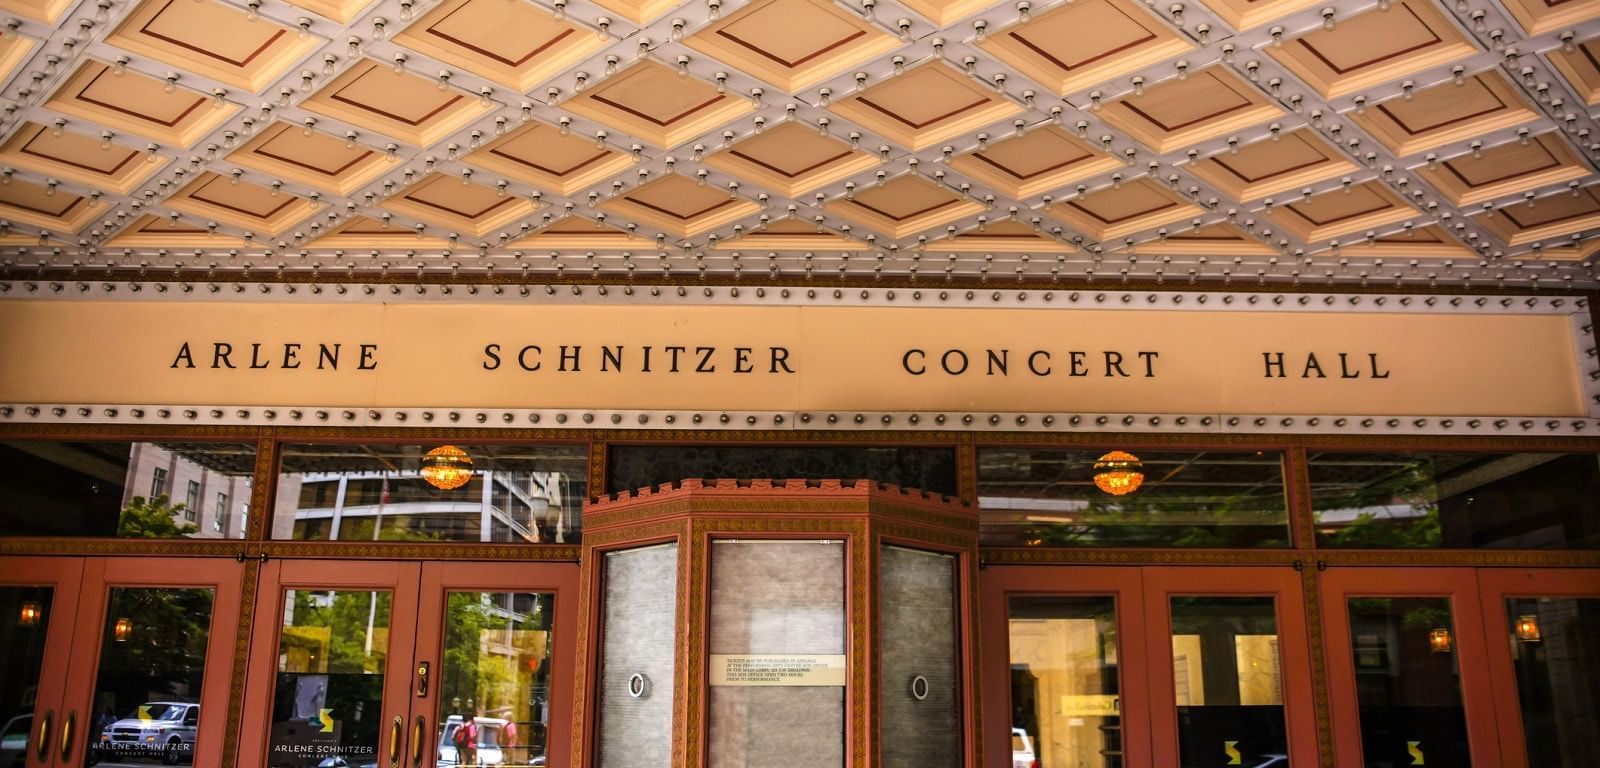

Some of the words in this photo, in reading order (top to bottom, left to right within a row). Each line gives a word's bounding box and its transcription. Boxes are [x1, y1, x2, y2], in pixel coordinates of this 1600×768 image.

[170, 341, 379, 371] ARLENE
[482, 343, 797, 375] SCHNITZER
[902, 349, 1162, 379] CONCERT
[1263, 351, 1391, 380] HALL
[92, 742, 131, 750] ARLENE
[134, 743, 190, 751] SCHNITZER
[274, 745, 314, 753] ARLENE
[317, 745, 373, 754] SCHNITZER
